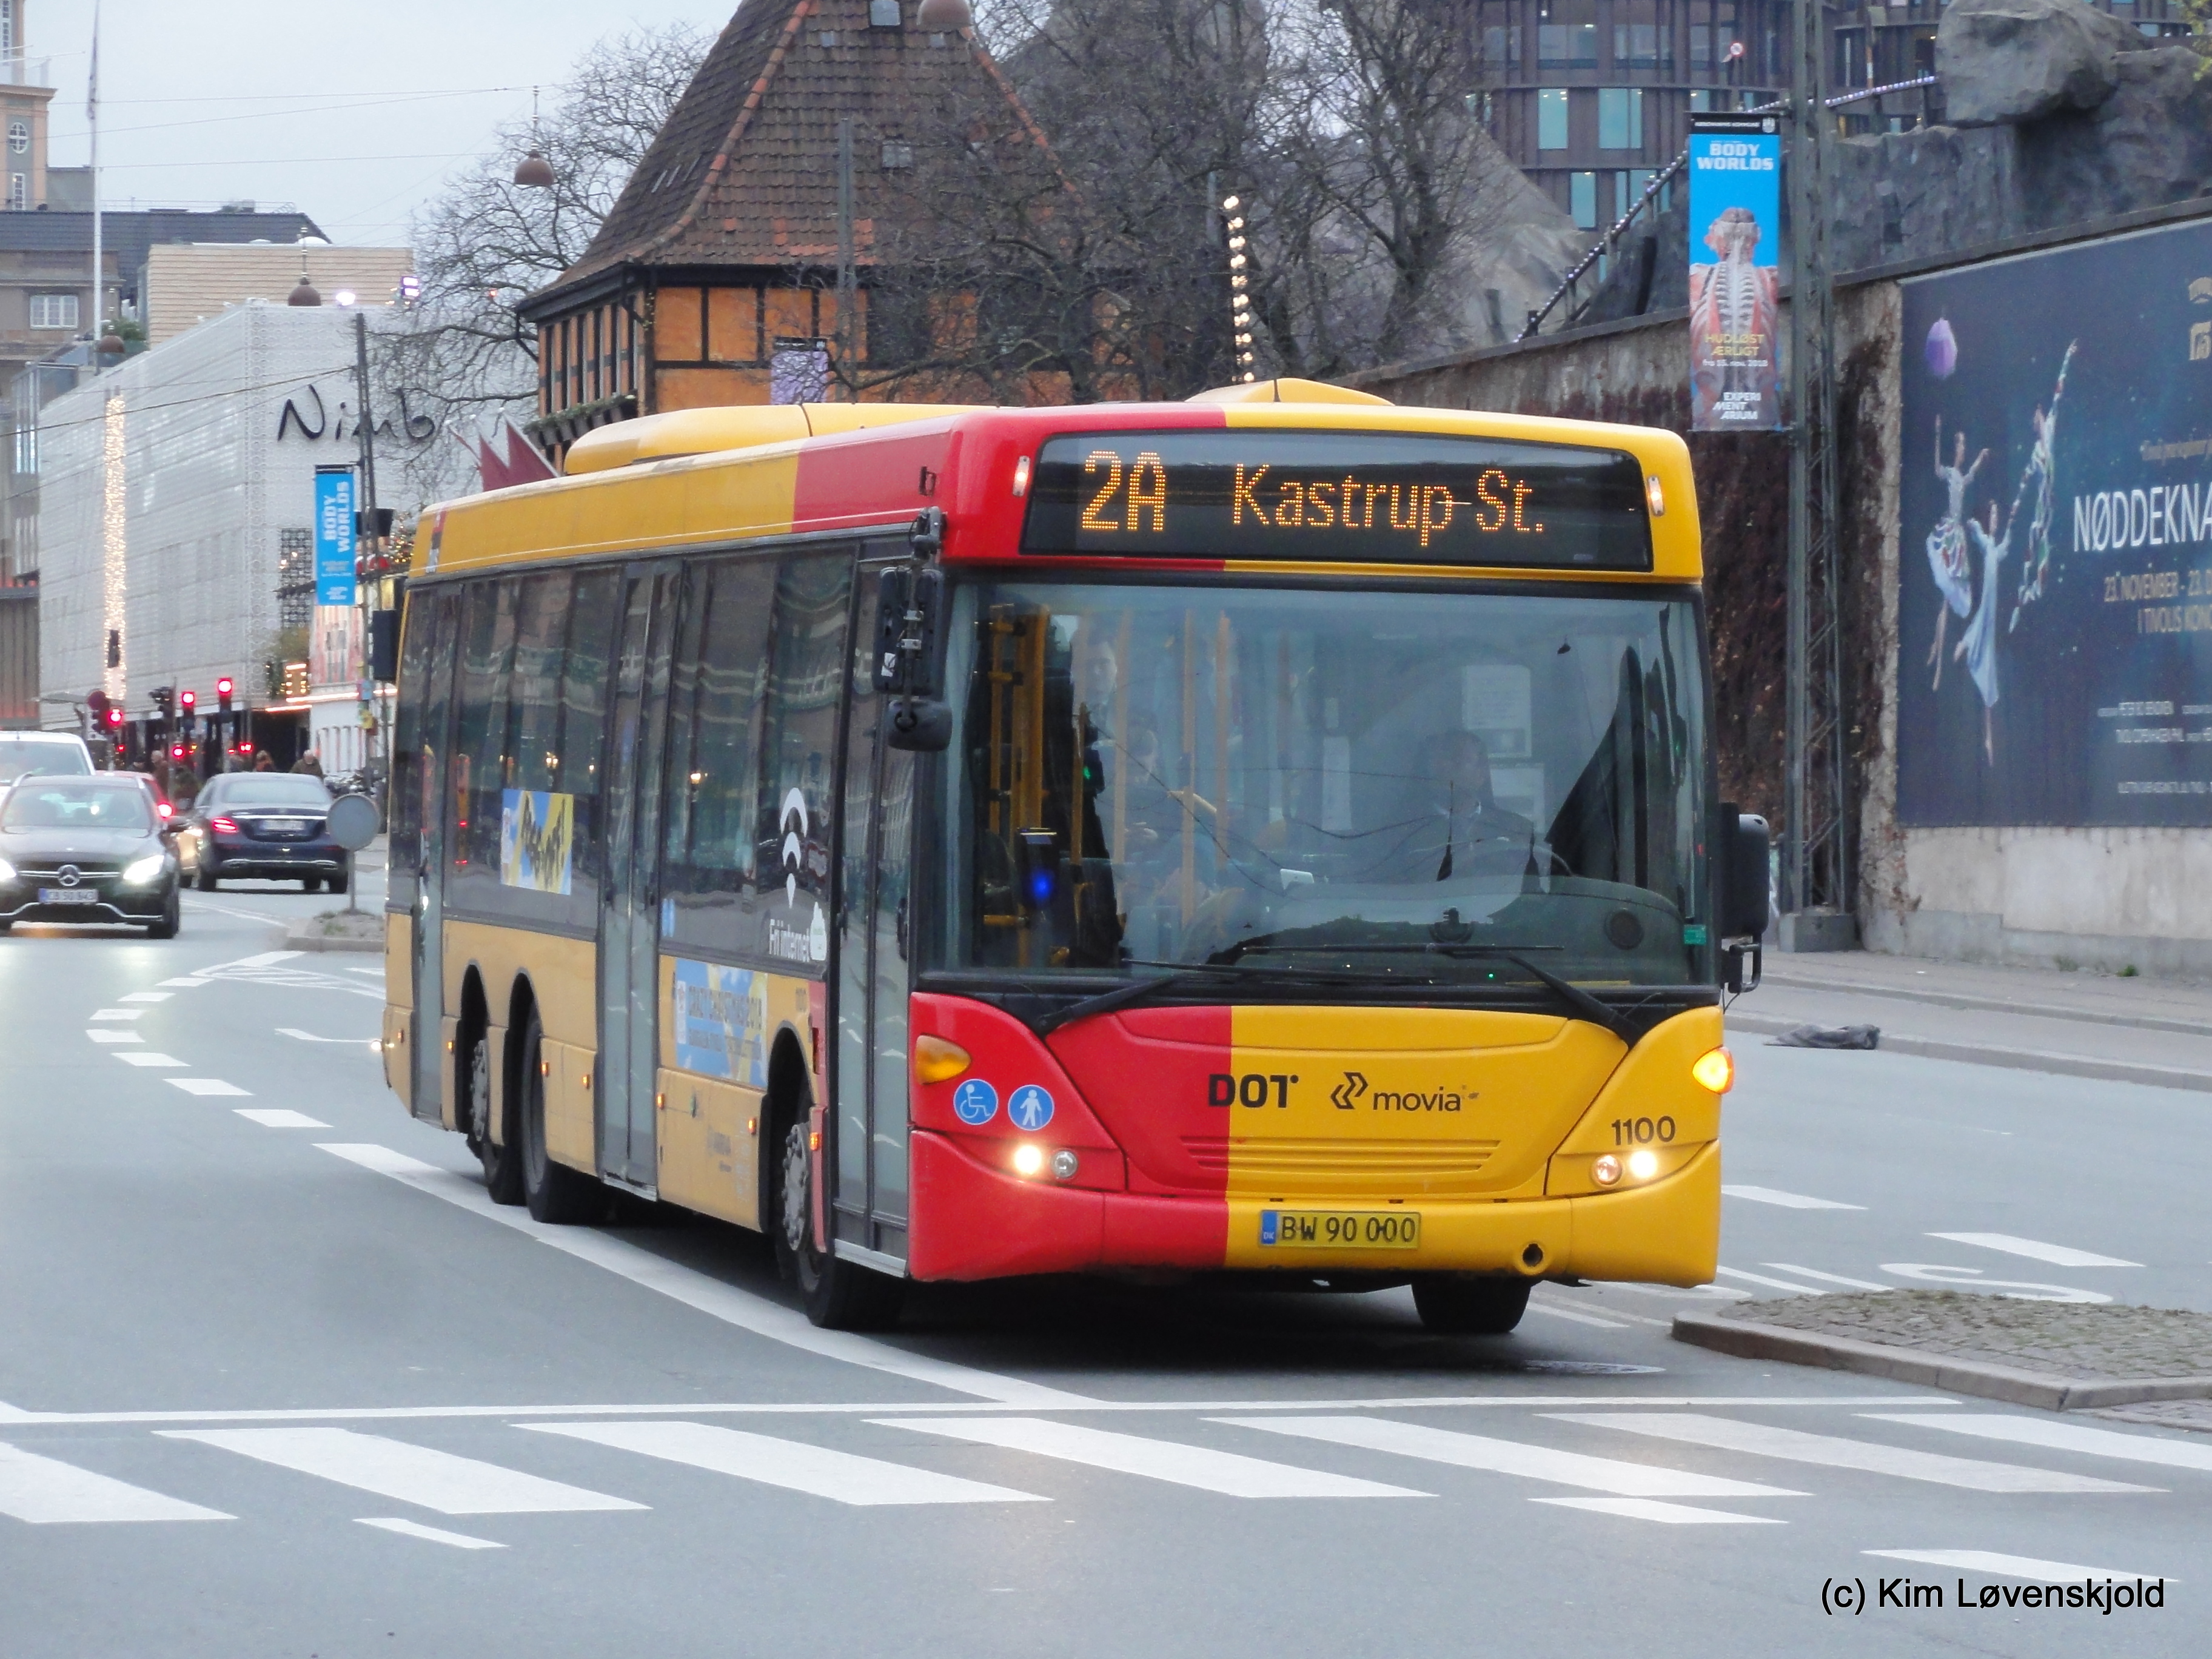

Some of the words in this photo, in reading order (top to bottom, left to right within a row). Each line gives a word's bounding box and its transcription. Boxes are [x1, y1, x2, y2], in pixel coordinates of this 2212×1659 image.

[1697, 157, 1774, 170] WORLDS
[1709, 143, 1760, 156] BODY
[278, 384, 435, 441] Nimb
[1082, 451, 1167, 531] 2A
[1233, 463, 1453, 546] Kastrup
[1476, 469, 1544, 532] St.
[323, 495, 337, 540] BODY
[337, 481, 350, 553] WORLDS
[1208, 1074, 1288, 1108] DOT
[1373, 1086, 1461, 1111] movia
[1611, 1116, 1676, 1145] 1100
[1282, 1216, 1318, 1241] BW
[1326, 1217, 1358, 1242] 90
[1366, 1217, 1416, 1242] 000
